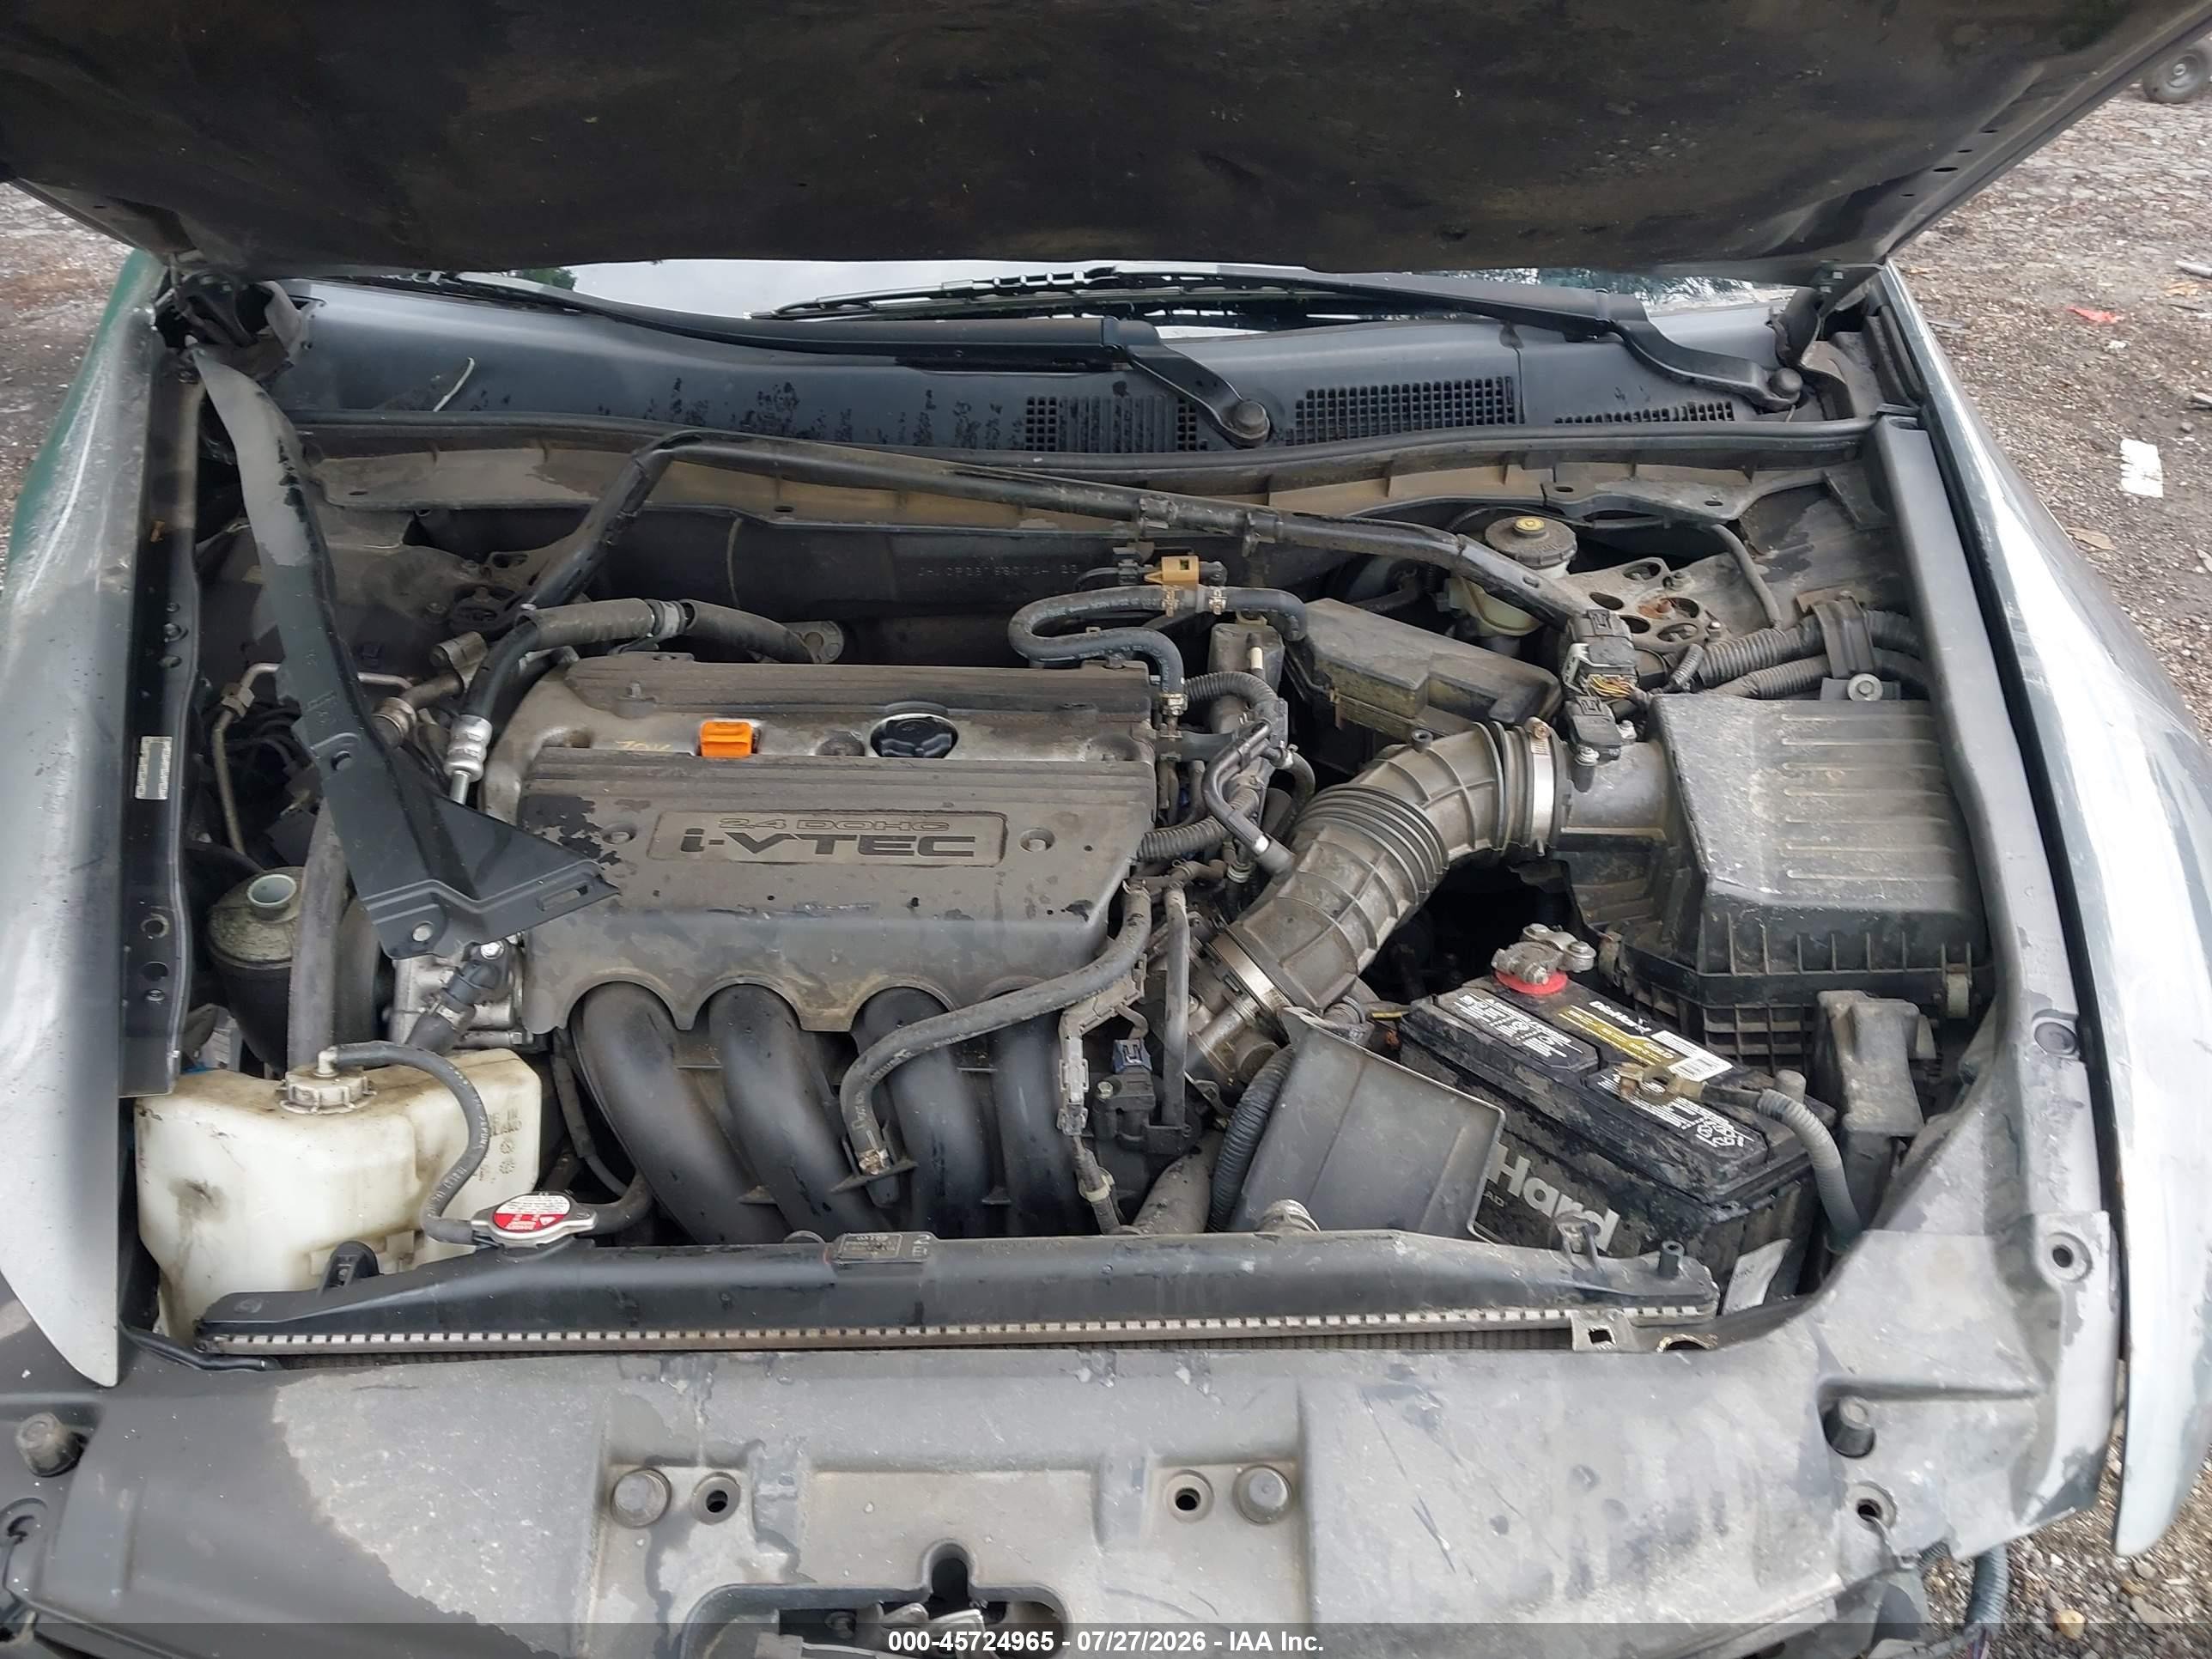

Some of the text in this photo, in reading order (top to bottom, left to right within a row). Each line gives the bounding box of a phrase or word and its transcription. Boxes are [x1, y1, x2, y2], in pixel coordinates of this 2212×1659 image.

[796, 818, 950, 832] DOHC
[679, 827, 976, 858] i-VTEC
[1643, 1042, 1675, 1060] GOLD
[1486, 1140, 1620, 1253] Hard
